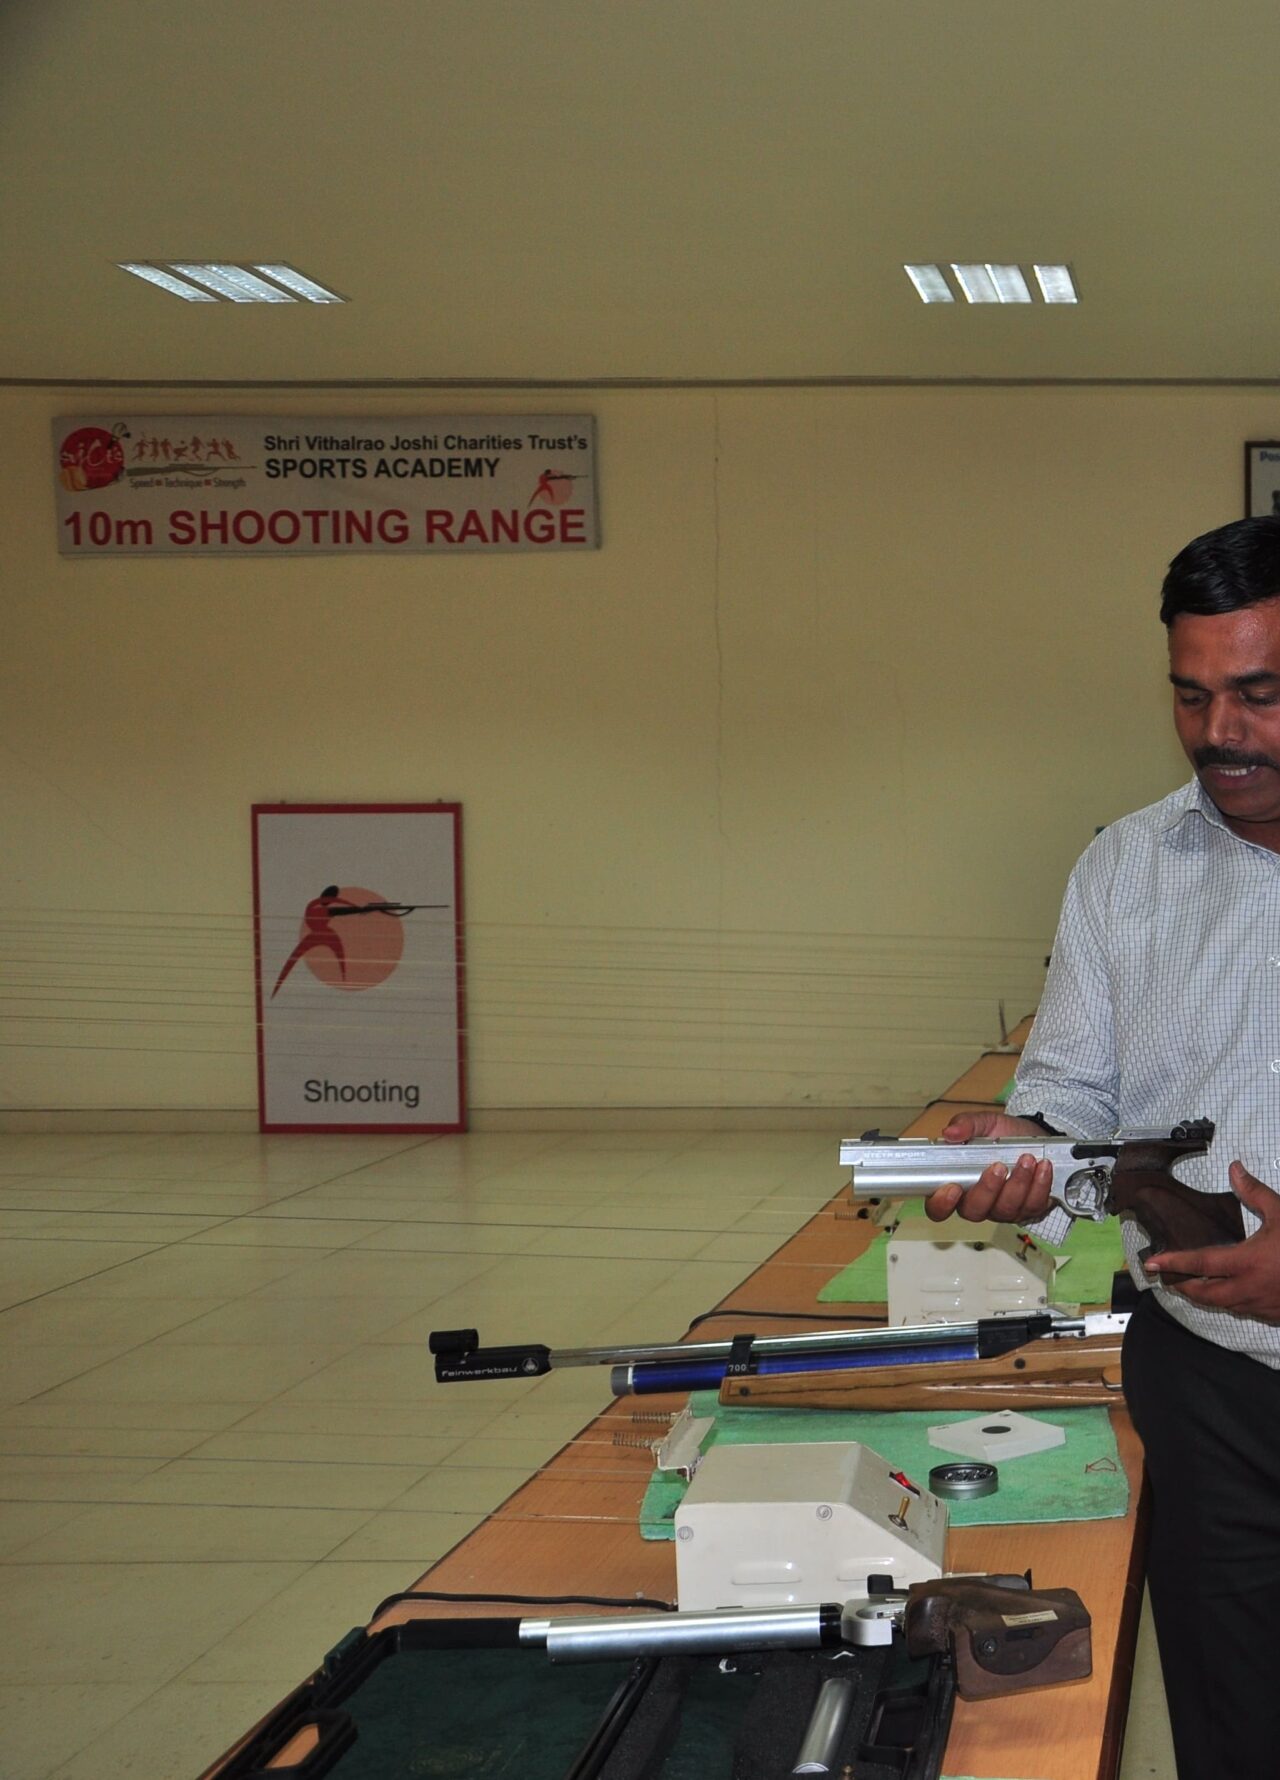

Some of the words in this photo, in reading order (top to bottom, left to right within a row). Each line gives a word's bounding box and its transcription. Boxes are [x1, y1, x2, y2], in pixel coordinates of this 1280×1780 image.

[263, 435, 300, 451] Shri
[305, 435, 384, 451] Vithalrao
[390, 434, 438, 451] Joshi
[444, 434, 523, 450] Charities
[528, 434, 588, 450] Trust's
[265, 457, 368, 479] SPORTS
[374, 457, 501, 478] ACADEMY
[130, 478, 155, 489] Speed
[164, 478, 203, 488] Technique
[213, 478, 247, 489] Strength
[63, 511, 153, 546] 10m
[168, 509, 410, 545] SHOOTING
[425, 508, 588, 544] RANGE
[303, 1079, 420, 1109] Shooting
[441, 1366, 518, 1377] feinwerkbau
[728, 1363, 747, 1373] 700
